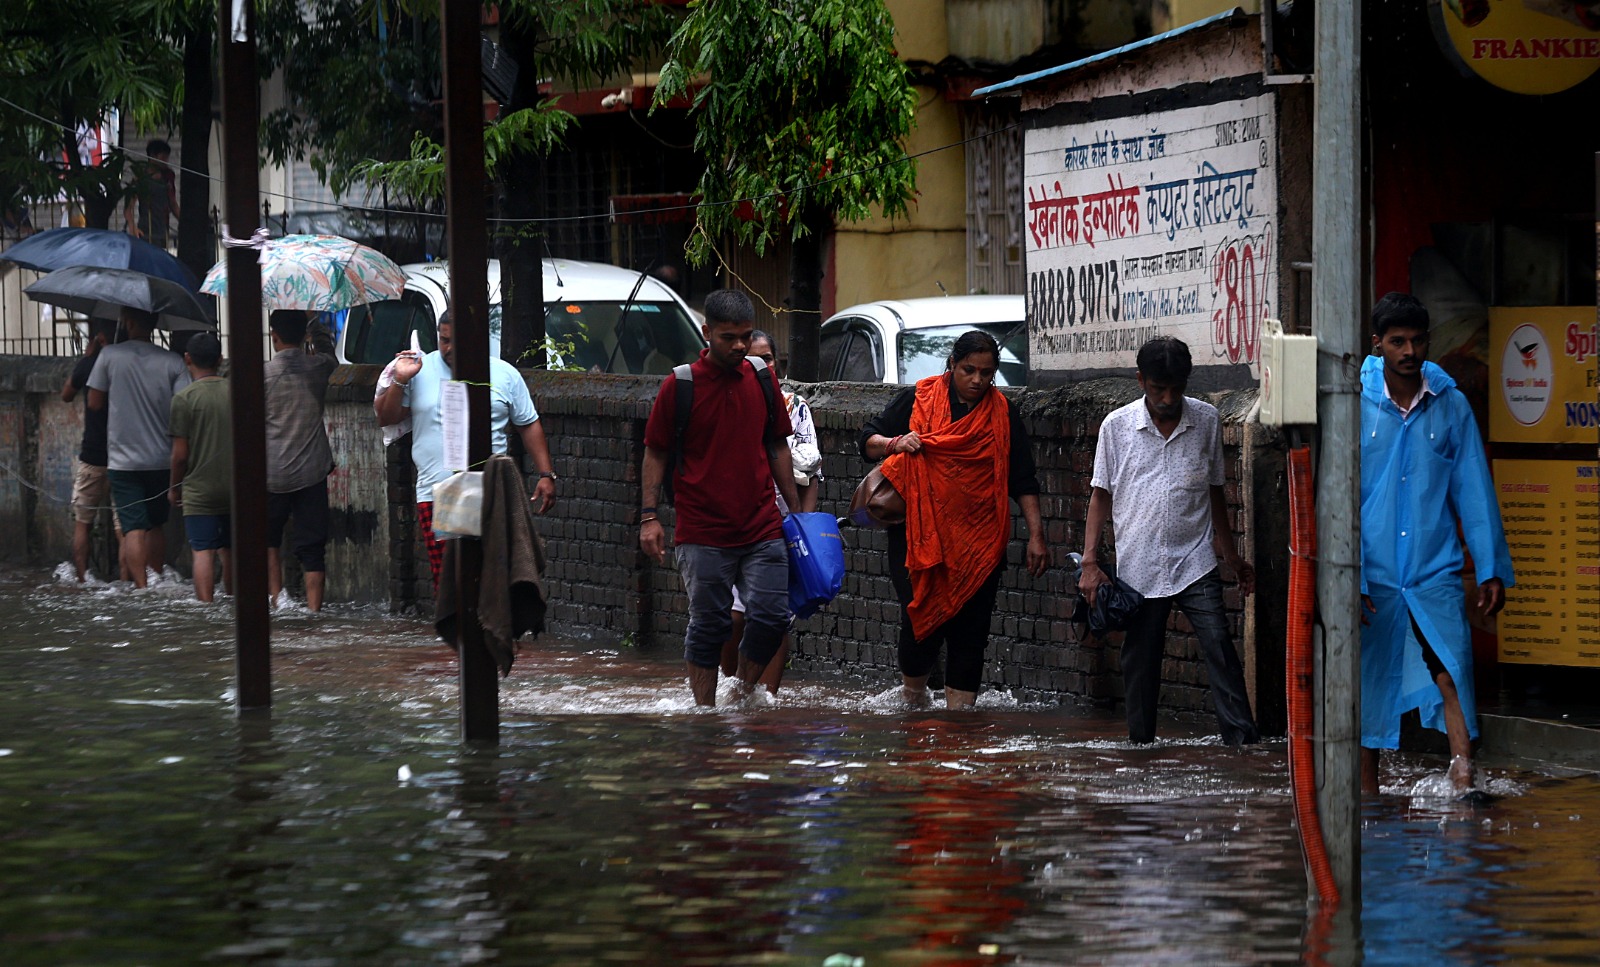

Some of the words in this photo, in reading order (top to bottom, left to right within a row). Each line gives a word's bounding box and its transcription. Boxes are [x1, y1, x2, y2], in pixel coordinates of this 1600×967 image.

[1472, 37, 1600, 59] FRANKIE
[1110, 130, 1118, 165] के
[1121, 137, 1144, 163] साथ
[1147, 127, 1166, 161] जॉब
